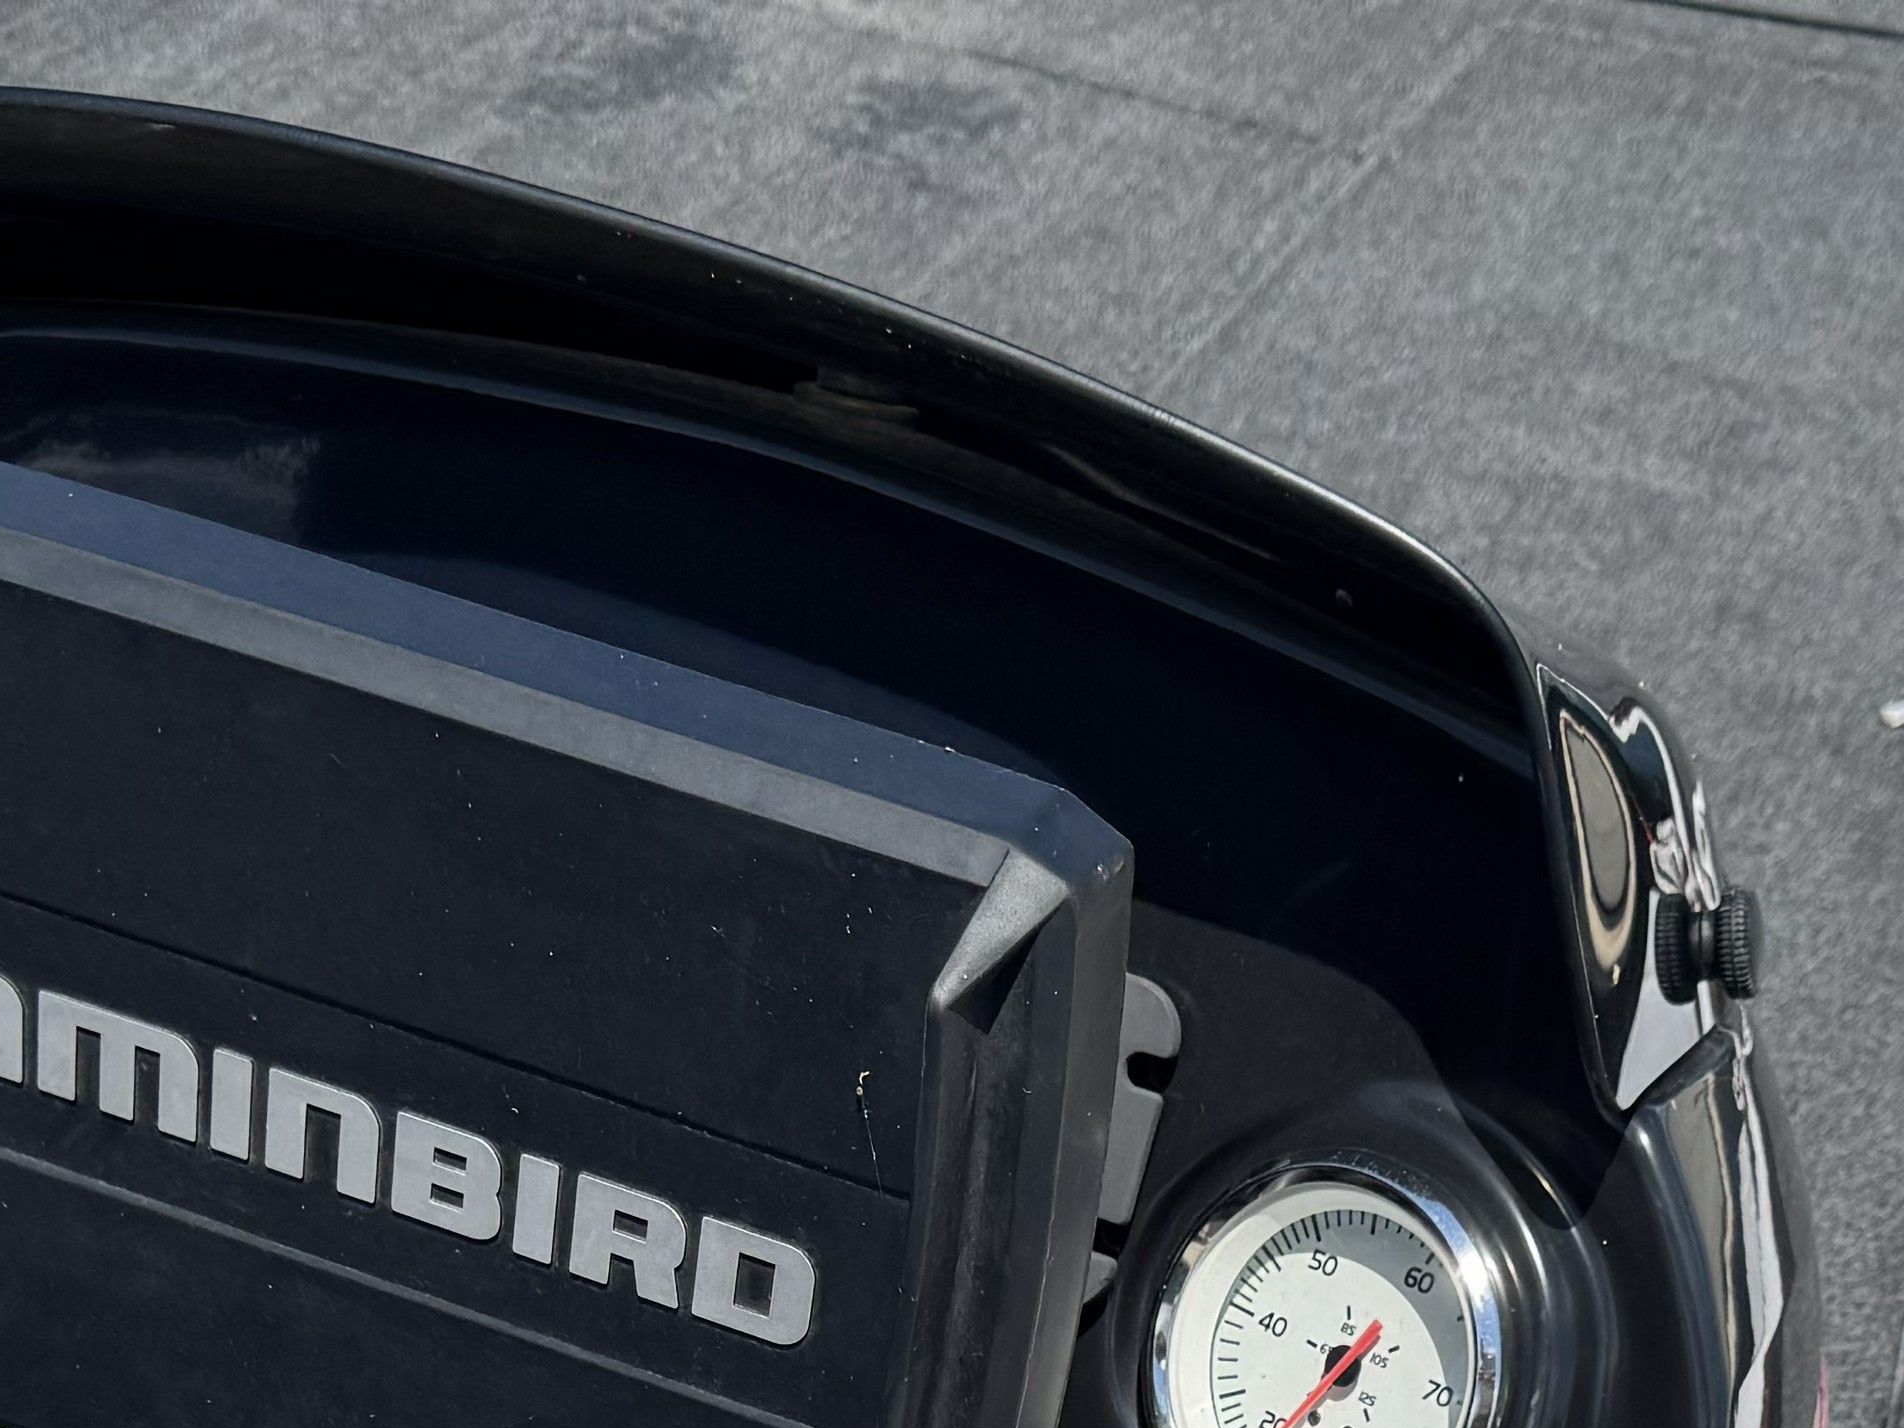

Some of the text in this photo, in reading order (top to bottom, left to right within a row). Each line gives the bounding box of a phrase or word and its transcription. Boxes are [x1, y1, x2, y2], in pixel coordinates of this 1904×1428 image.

[1308, 1249, 1340, 1277] 50
[1403, 1266, 1434, 1295] 60
[1258, 1311, 1288, 1338] 40
[1421, 1379, 1454, 1408] 70
